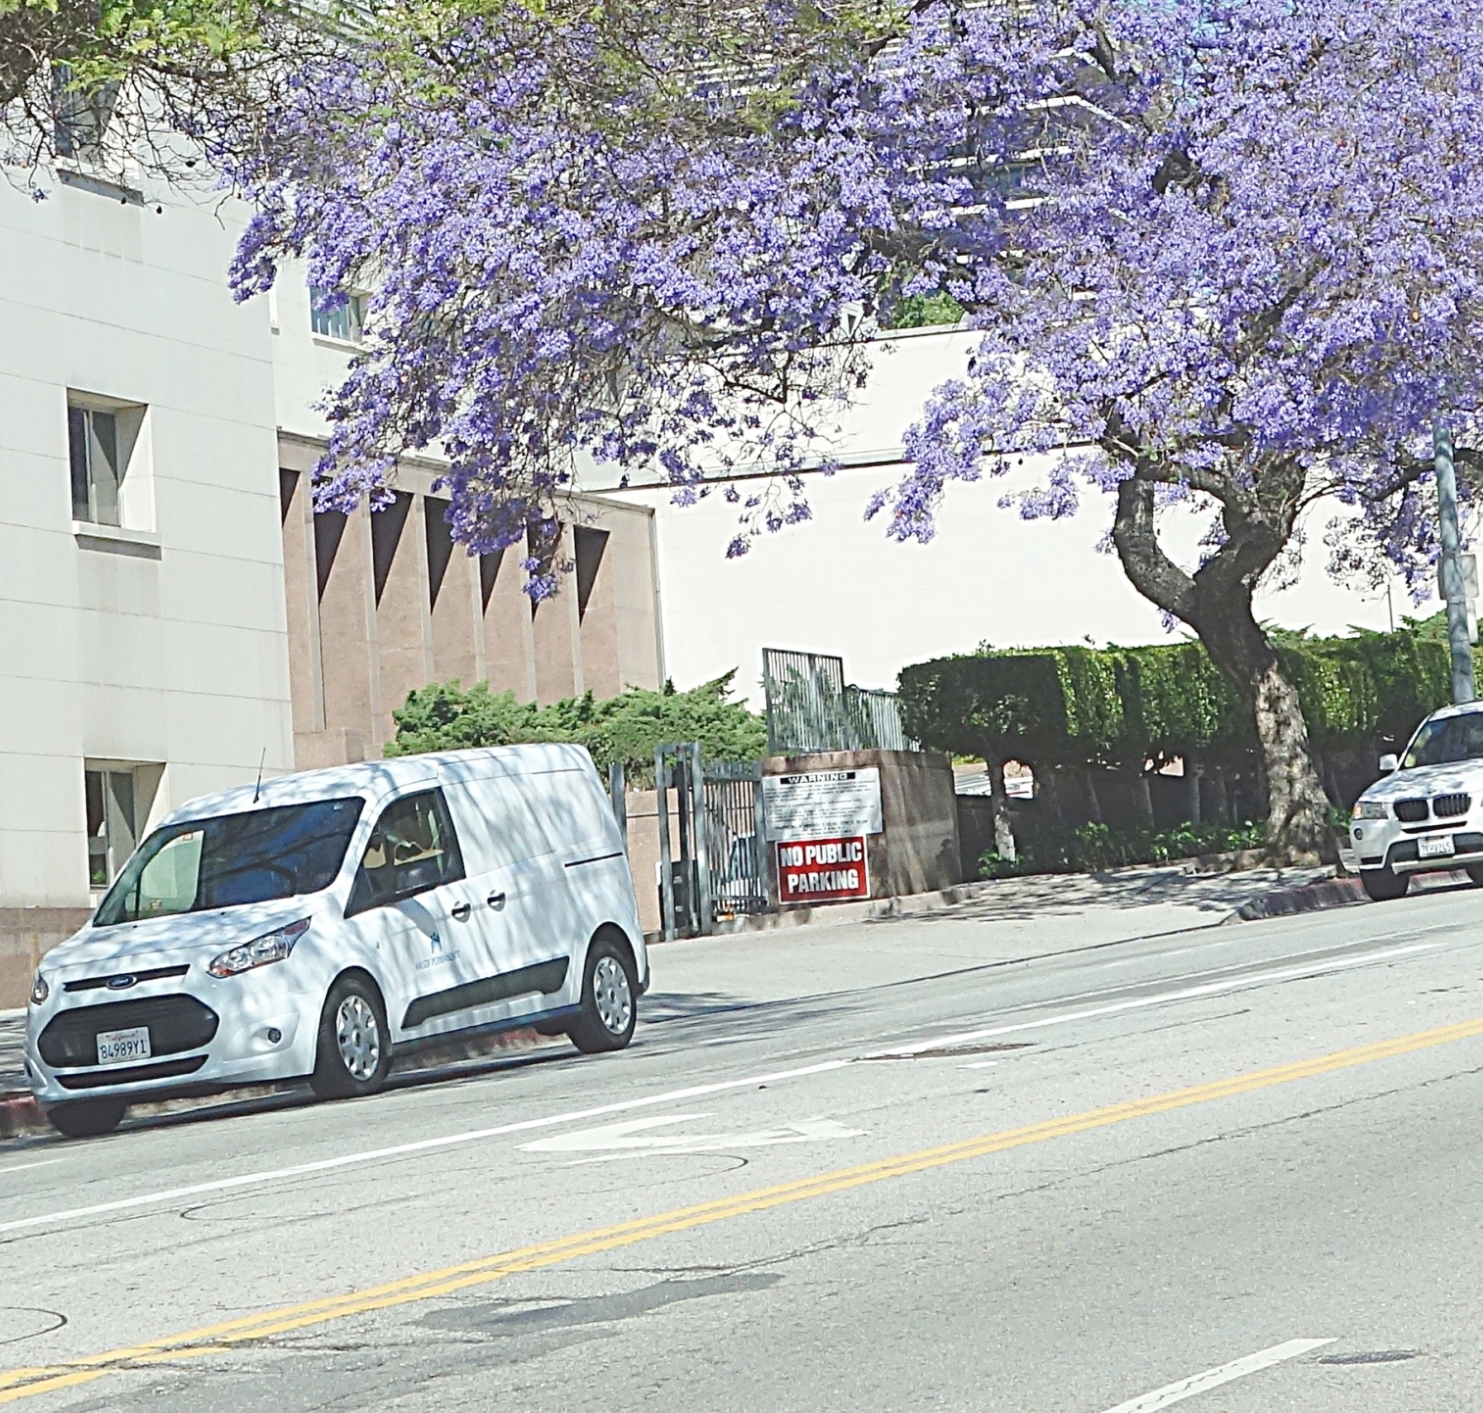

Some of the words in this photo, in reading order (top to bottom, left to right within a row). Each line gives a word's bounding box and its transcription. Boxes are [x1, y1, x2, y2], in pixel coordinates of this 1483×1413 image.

[788, 772, 848, 785] WARNING
[780, 846, 804, 867] NO
[805, 841, 863, 866] PUBLIC
[787, 869, 859, 894] PARKING
[101, 1039, 147, 1059] 84989Y1
